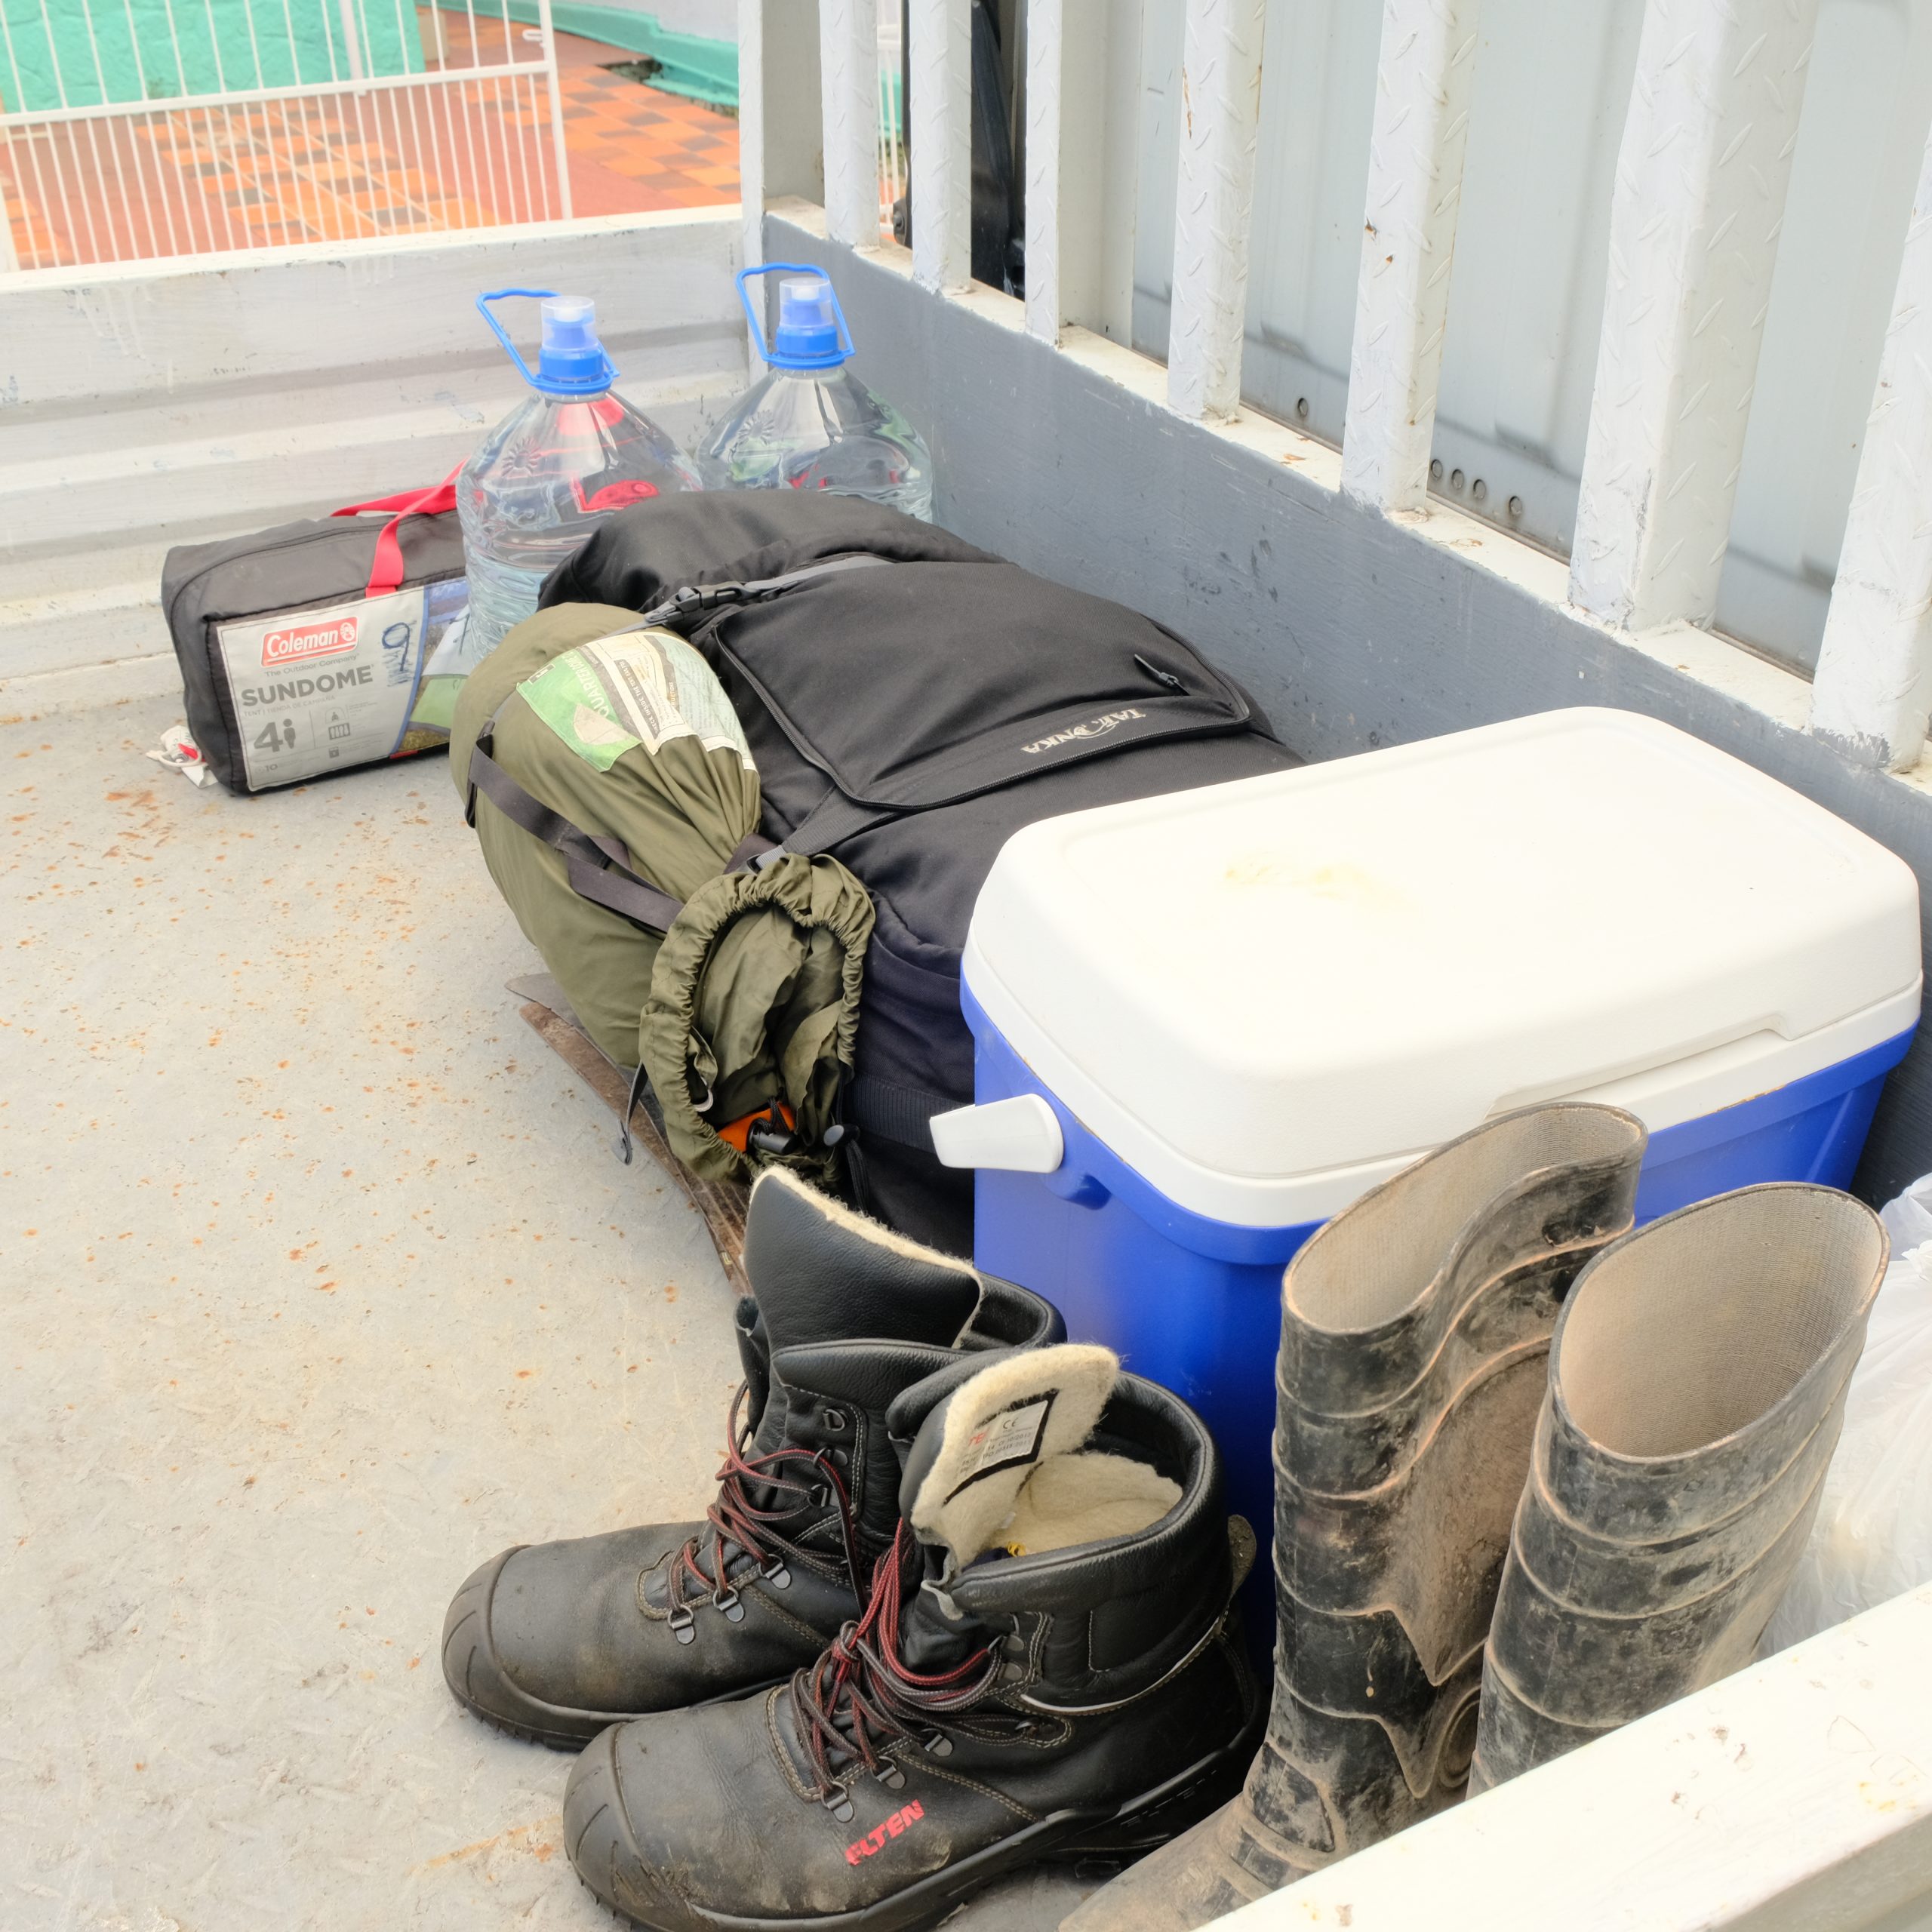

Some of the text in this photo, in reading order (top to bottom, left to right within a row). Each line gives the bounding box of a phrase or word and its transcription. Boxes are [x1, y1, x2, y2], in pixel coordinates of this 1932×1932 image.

[266, 628, 339, 658] Coleman
[264, 669, 281, 678] The
[283, 662, 317, 675] Outdoor
[241, 664, 374, 707] SUNDOME
[244, 709, 261, 718] TENT
[253, 721, 284, 752] 4
